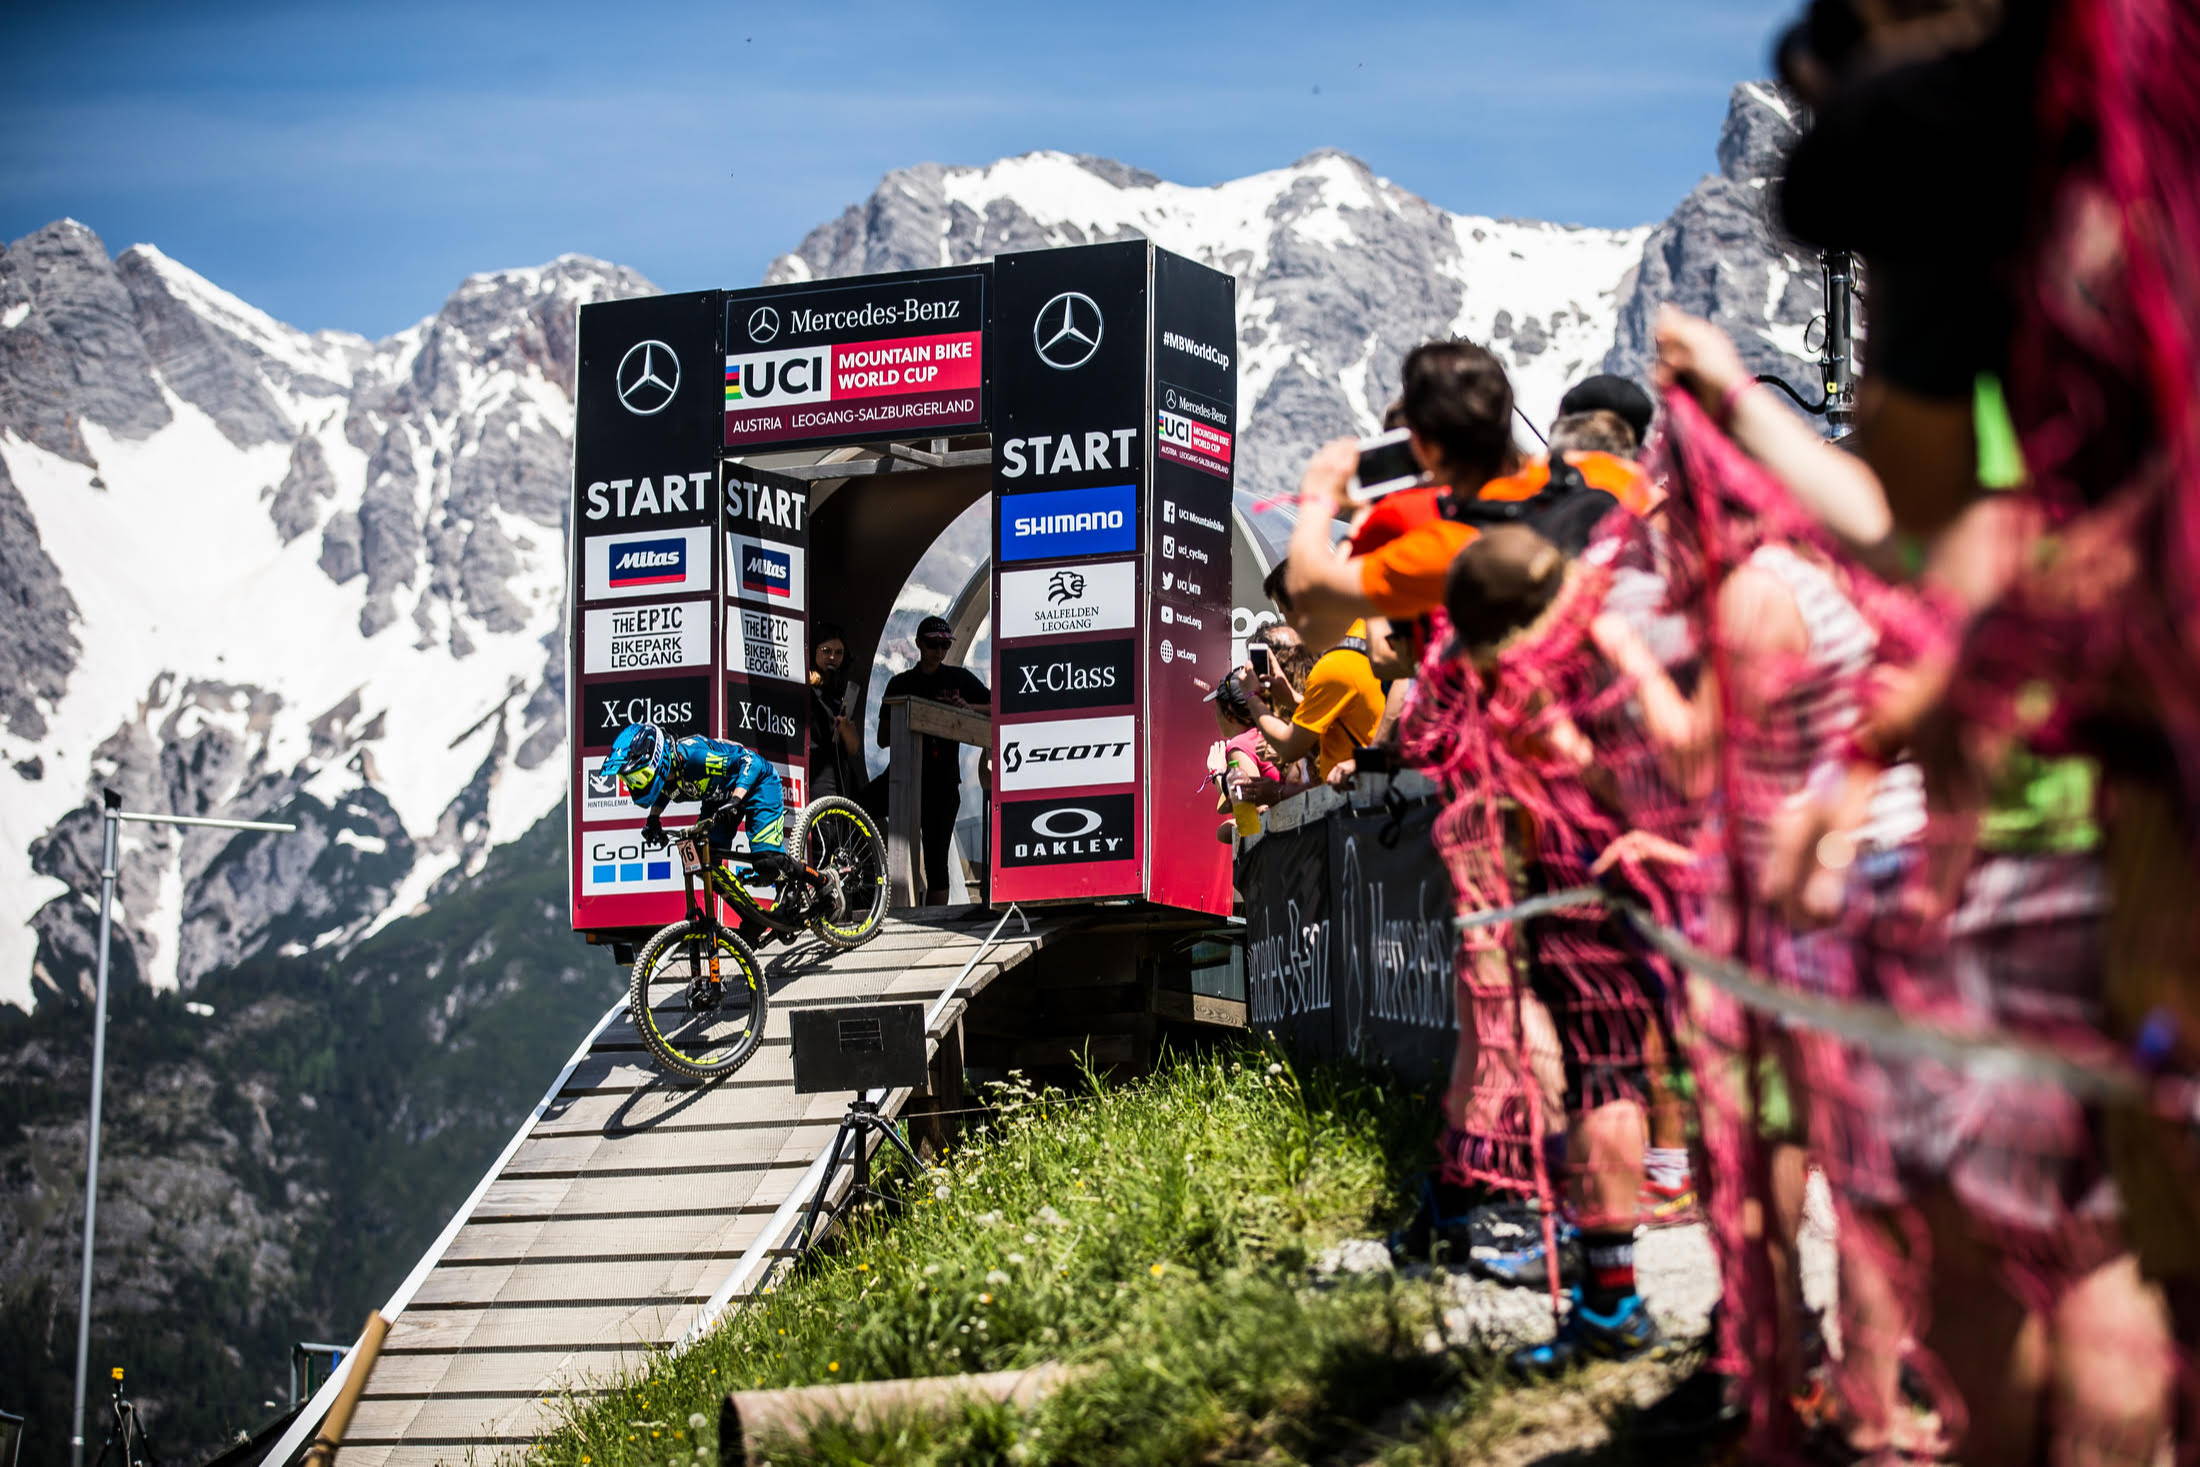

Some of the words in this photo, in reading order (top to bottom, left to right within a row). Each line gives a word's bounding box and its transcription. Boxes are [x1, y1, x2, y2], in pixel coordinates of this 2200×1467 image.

[790, 299, 960, 334] Mercedes-Benz
[838, 346, 930, 369] MOUNTAIN
[935, 342, 972, 360] BIKE
[1163, 331, 1229, 371] #MBWorldCup
[744, 357, 822, 398] UCI
[838, 369, 900, 390] WORLD
[904, 366, 938, 383] CUP
[733, 417, 782, 433] AUSTRIA
[792, 400, 974, 428] LEOGANG-SALZBURGERLAND
[1179, 396, 1227, 425] Mercedes-Benz
[1165, 416, 1189, 442] UCI
[1001, 428, 1137, 478] START
[1193, 437, 1210, 450] WORLD
[585, 472, 712, 521] START
[726, 479, 805, 531] START
[1015, 510, 1123, 537] SHIMANO
[1178, 508, 1189, 520] UCI
[1190, 512, 1225, 533] Mountainbike
[615, 550, 680, 570] Mitas
[1178, 545, 1208, 564] uci_cycling
[747, 557, 787, 579] Mitas
[1177, 579, 1201, 595] UCI_MTB
[613, 616, 635, 634] THE
[637, 607, 683, 631] EPIC
[1034, 606, 1099, 621] SAALFELDEN
[1042, 619, 1091, 632] LEOGANG
[745, 619, 759, 637] THE
[760, 616, 789, 642] EPIC
[612, 637, 682, 654] BIKEPARK
[745, 643, 788, 663] BIKEPARK
[612, 651, 683, 668] LEOGANG
[745, 656, 789, 677] LEOGANG
[1018, 662, 1116, 694] X-Class
[601, 697, 692, 728] X-Class
[739, 701, 796, 737] X-Class
[1025, 742, 1131, 763] SCOTT
[588, 800, 628, 808] HINTERGLEMM
[593, 841, 680, 861] GoPr
[1015, 838, 1119, 858] OAKLEY
[1247, 899, 1331, 1023] ercedes-Benz
